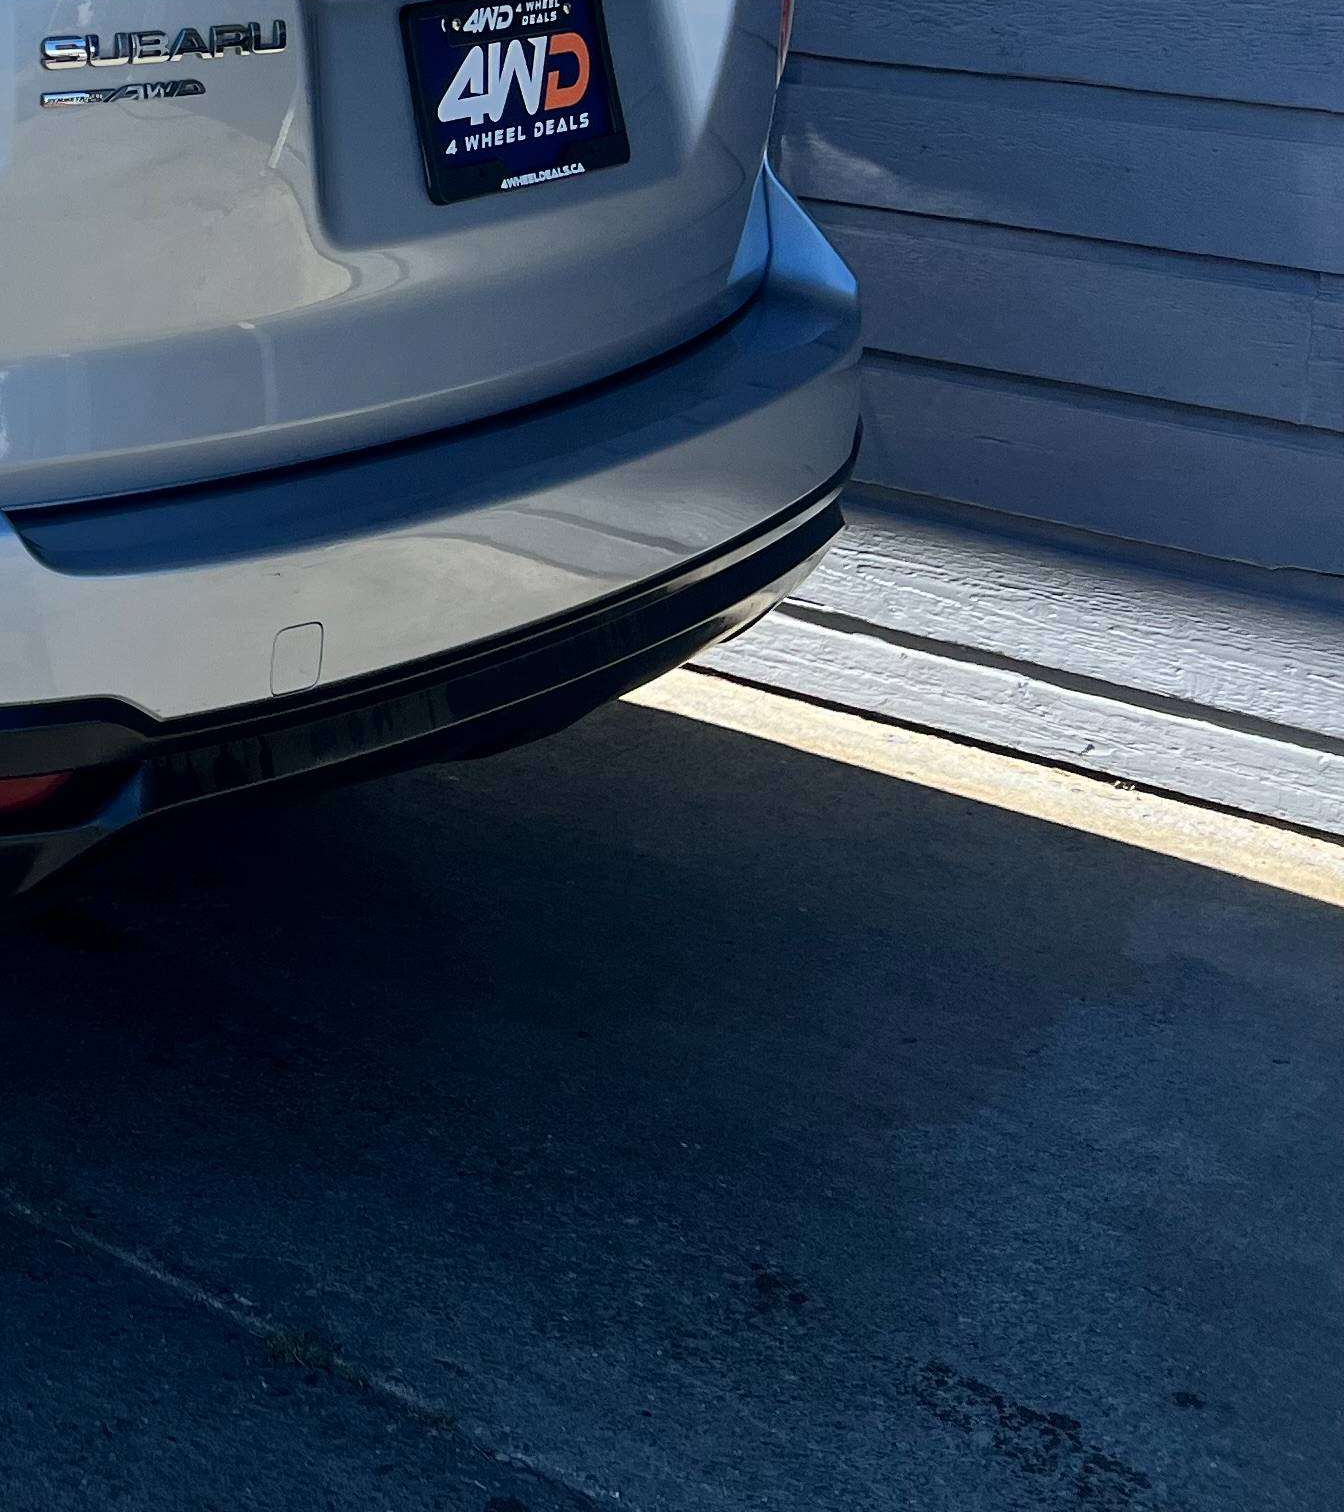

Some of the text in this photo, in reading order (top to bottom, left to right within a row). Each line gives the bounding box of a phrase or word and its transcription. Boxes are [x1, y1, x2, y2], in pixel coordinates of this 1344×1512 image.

[462, 4, 514, 34] 4WD
[515, 2, 523, 13] 4
[521, 10, 558, 26] DEALS
[40, 19, 287, 70] SUBARU
[437, 31, 591, 126] 4WD
[445, 111, 590, 155] 4 WHEEL DEALS
